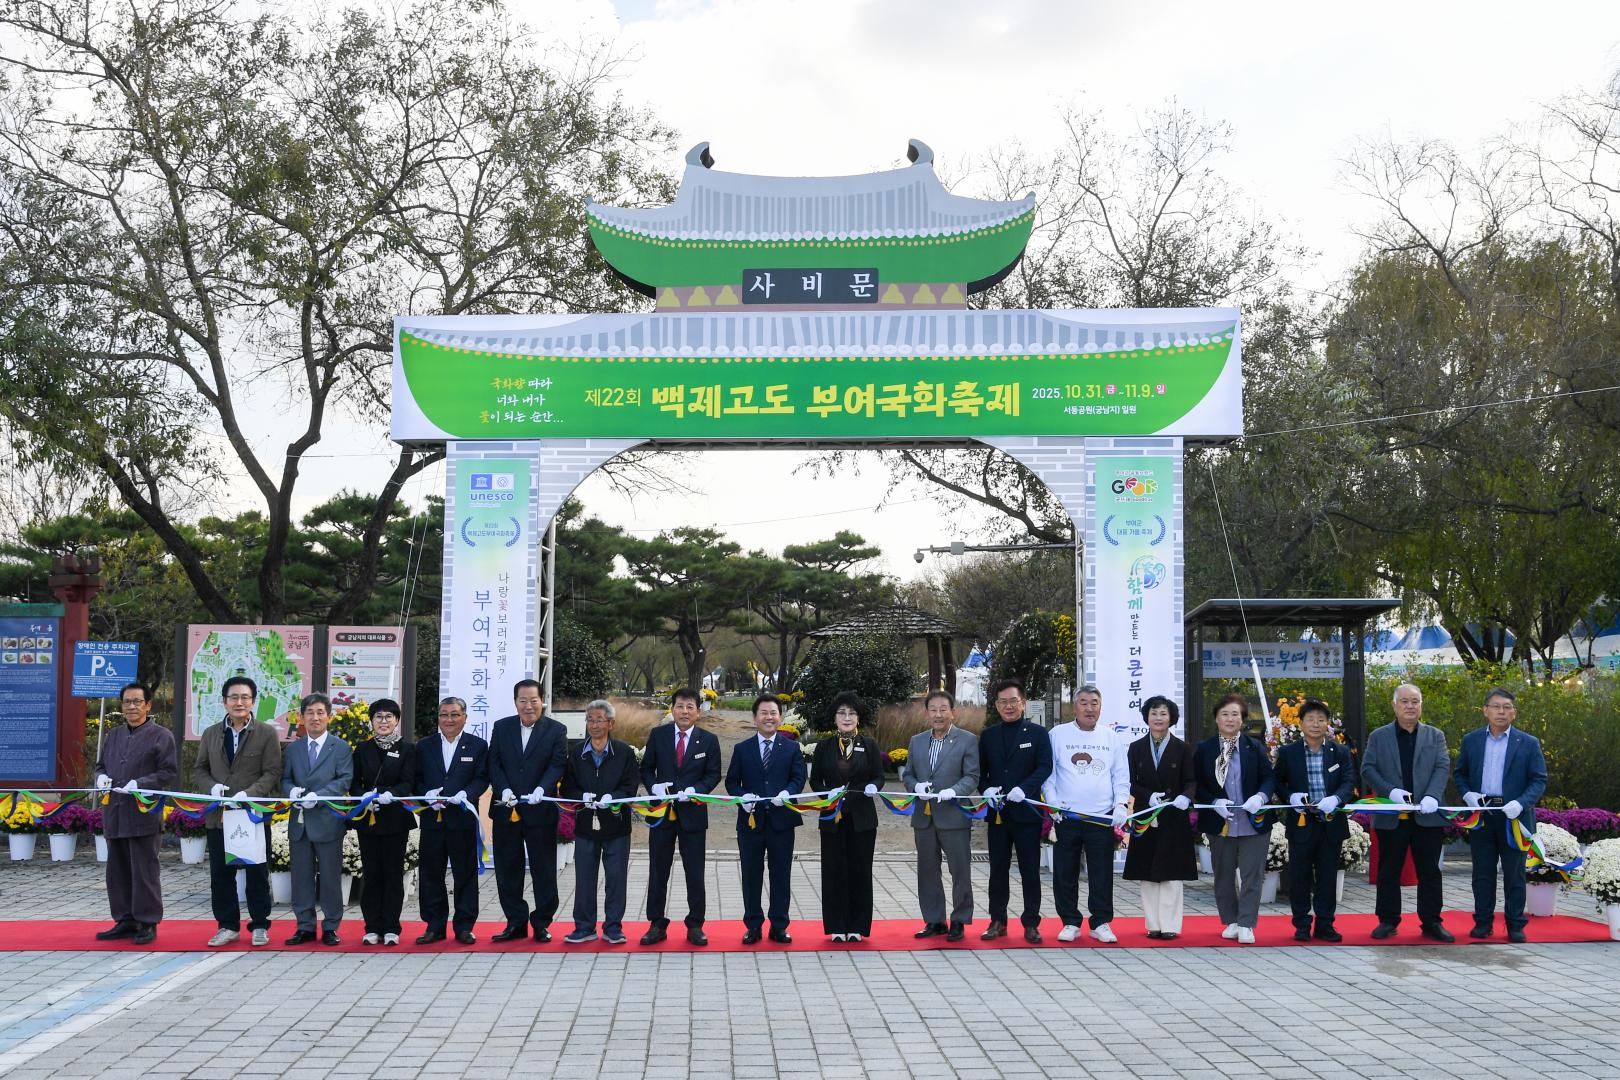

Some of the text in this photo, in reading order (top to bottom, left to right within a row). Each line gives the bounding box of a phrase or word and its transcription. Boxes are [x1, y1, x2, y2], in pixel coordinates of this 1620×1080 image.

[527, 377, 553, 390] 따라
[497, 394, 546, 406] 너와 내가
[584, 380, 1021, 419] 제22회 백제고도 부여국화축제
[1121, 405, 1137, 415] 일원
[479, 410, 500, 424] 꽃이
[503, 410, 526, 423] 되는
[470, 493, 514, 501] unesco
[77, 642, 96, 650] 장애인
